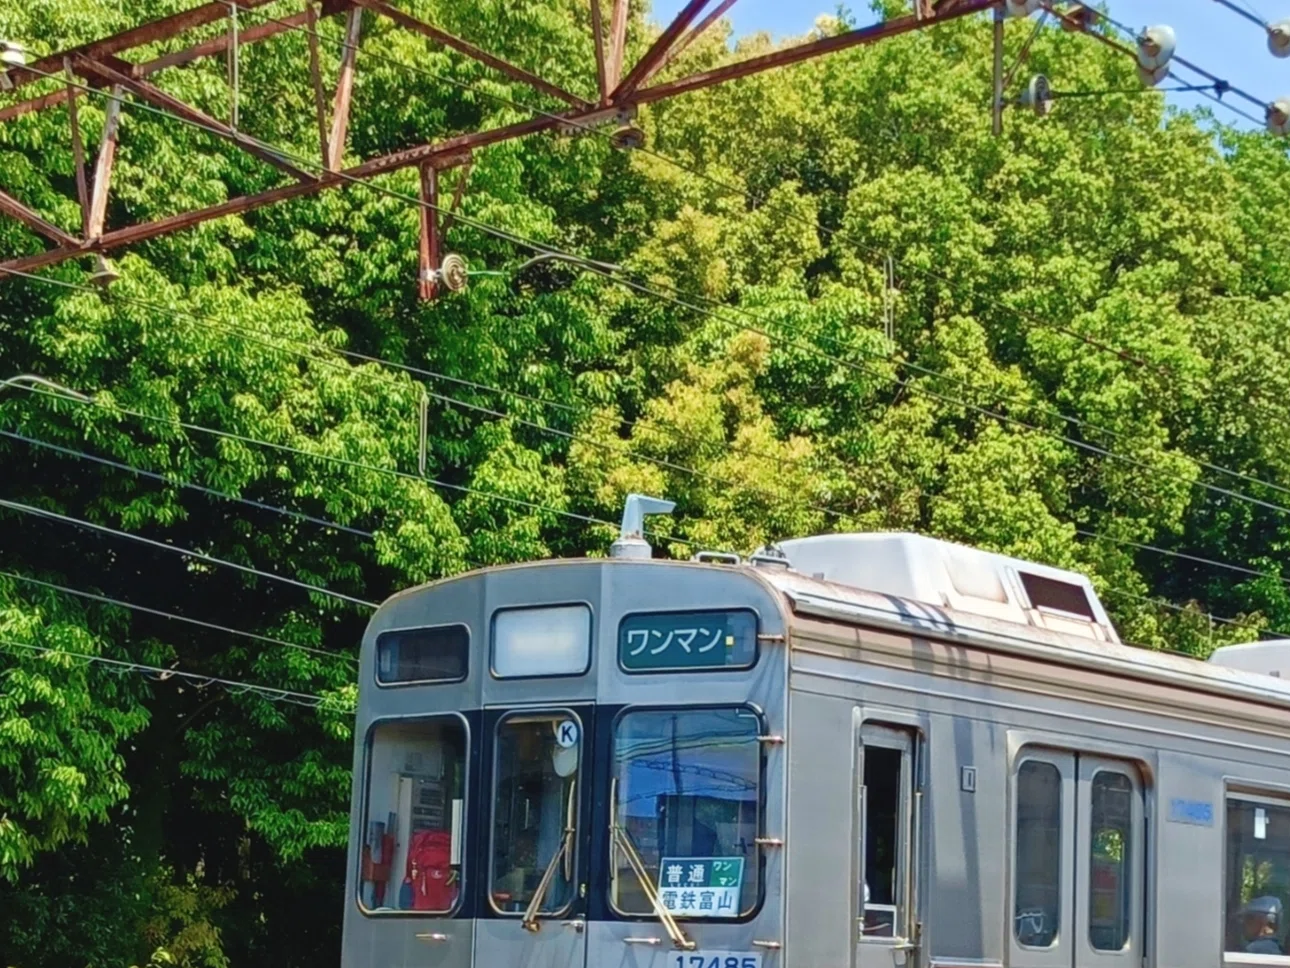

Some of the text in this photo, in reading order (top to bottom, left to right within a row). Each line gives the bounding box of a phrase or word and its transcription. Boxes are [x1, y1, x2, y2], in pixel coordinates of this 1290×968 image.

[627, 628, 722, 655] ワンマン
[561, 724, 574, 743] K
[666, 863, 705, 883] 普通
[713, 861, 732, 871] ワン
[719, 876, 737, 887] マン
[662, 890, 733, 910] 電鉄富山
